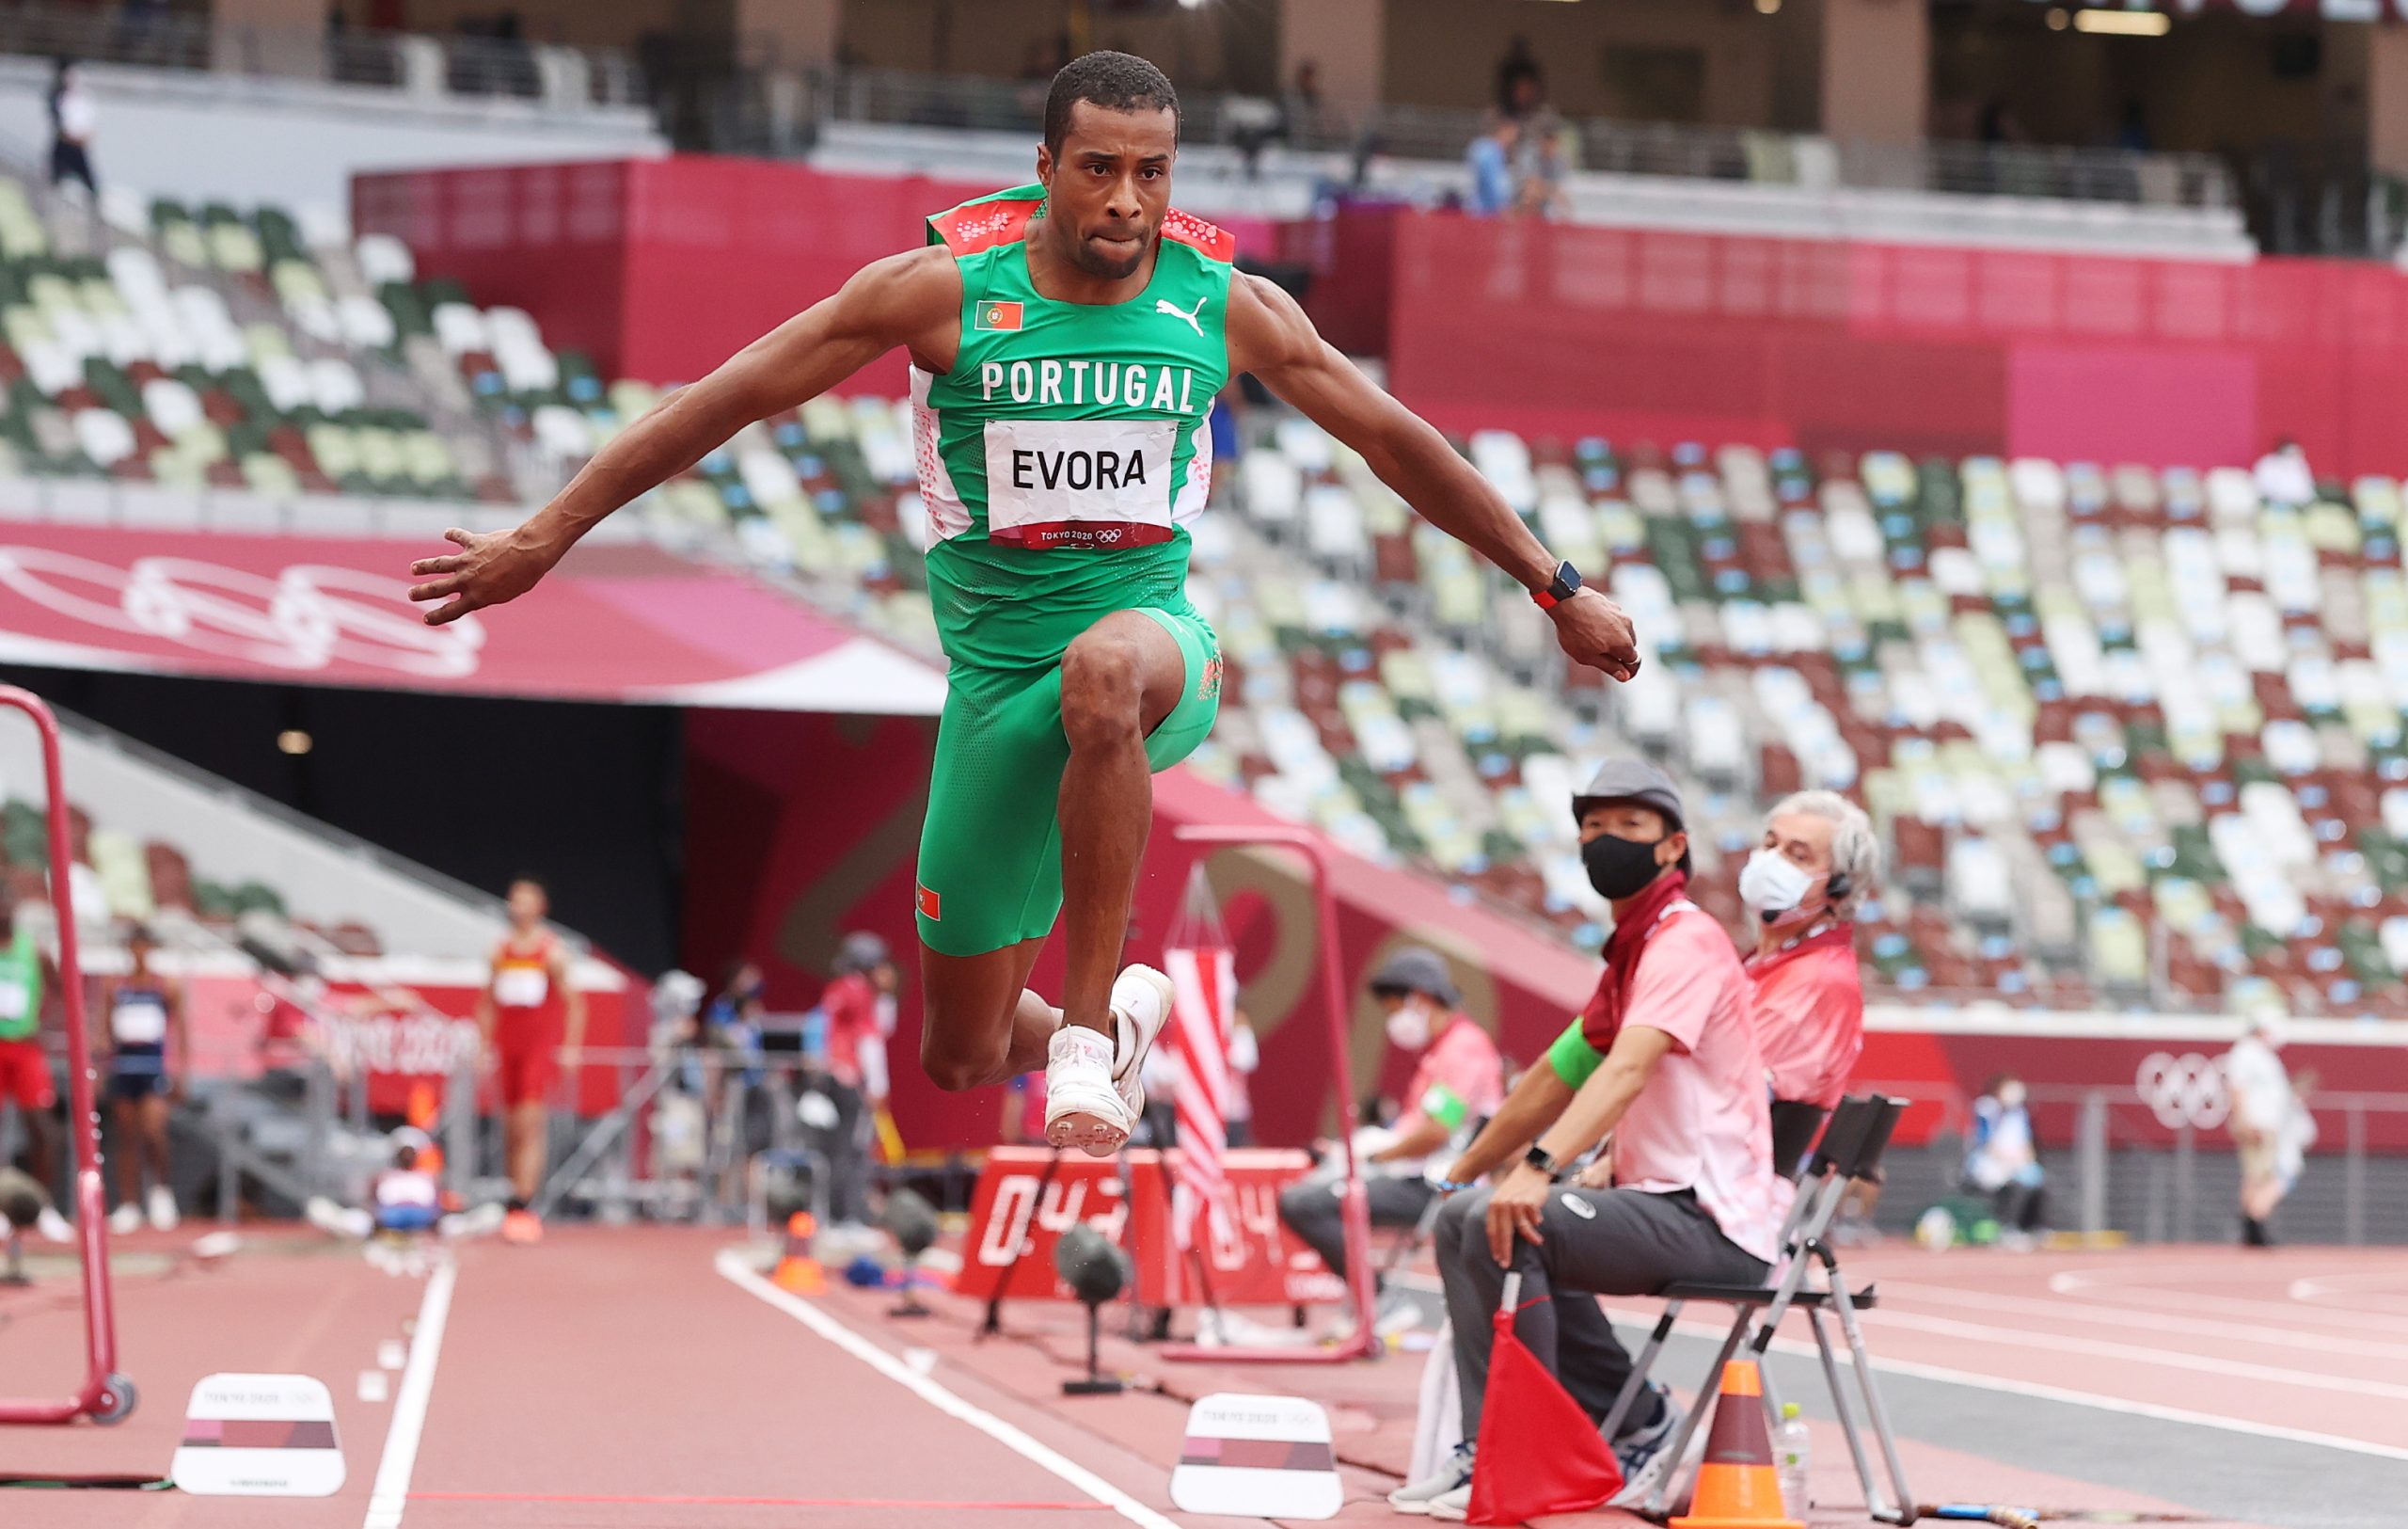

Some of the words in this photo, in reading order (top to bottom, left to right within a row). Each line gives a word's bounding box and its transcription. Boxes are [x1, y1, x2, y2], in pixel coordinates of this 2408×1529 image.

[981, 359, 1194, 412] PORTUGAL
[1012, 449, 1147, 490] EVORA
[1041, 531, 1070, 541] TOKYO
[1071, 531, 1093, 540] 2020
